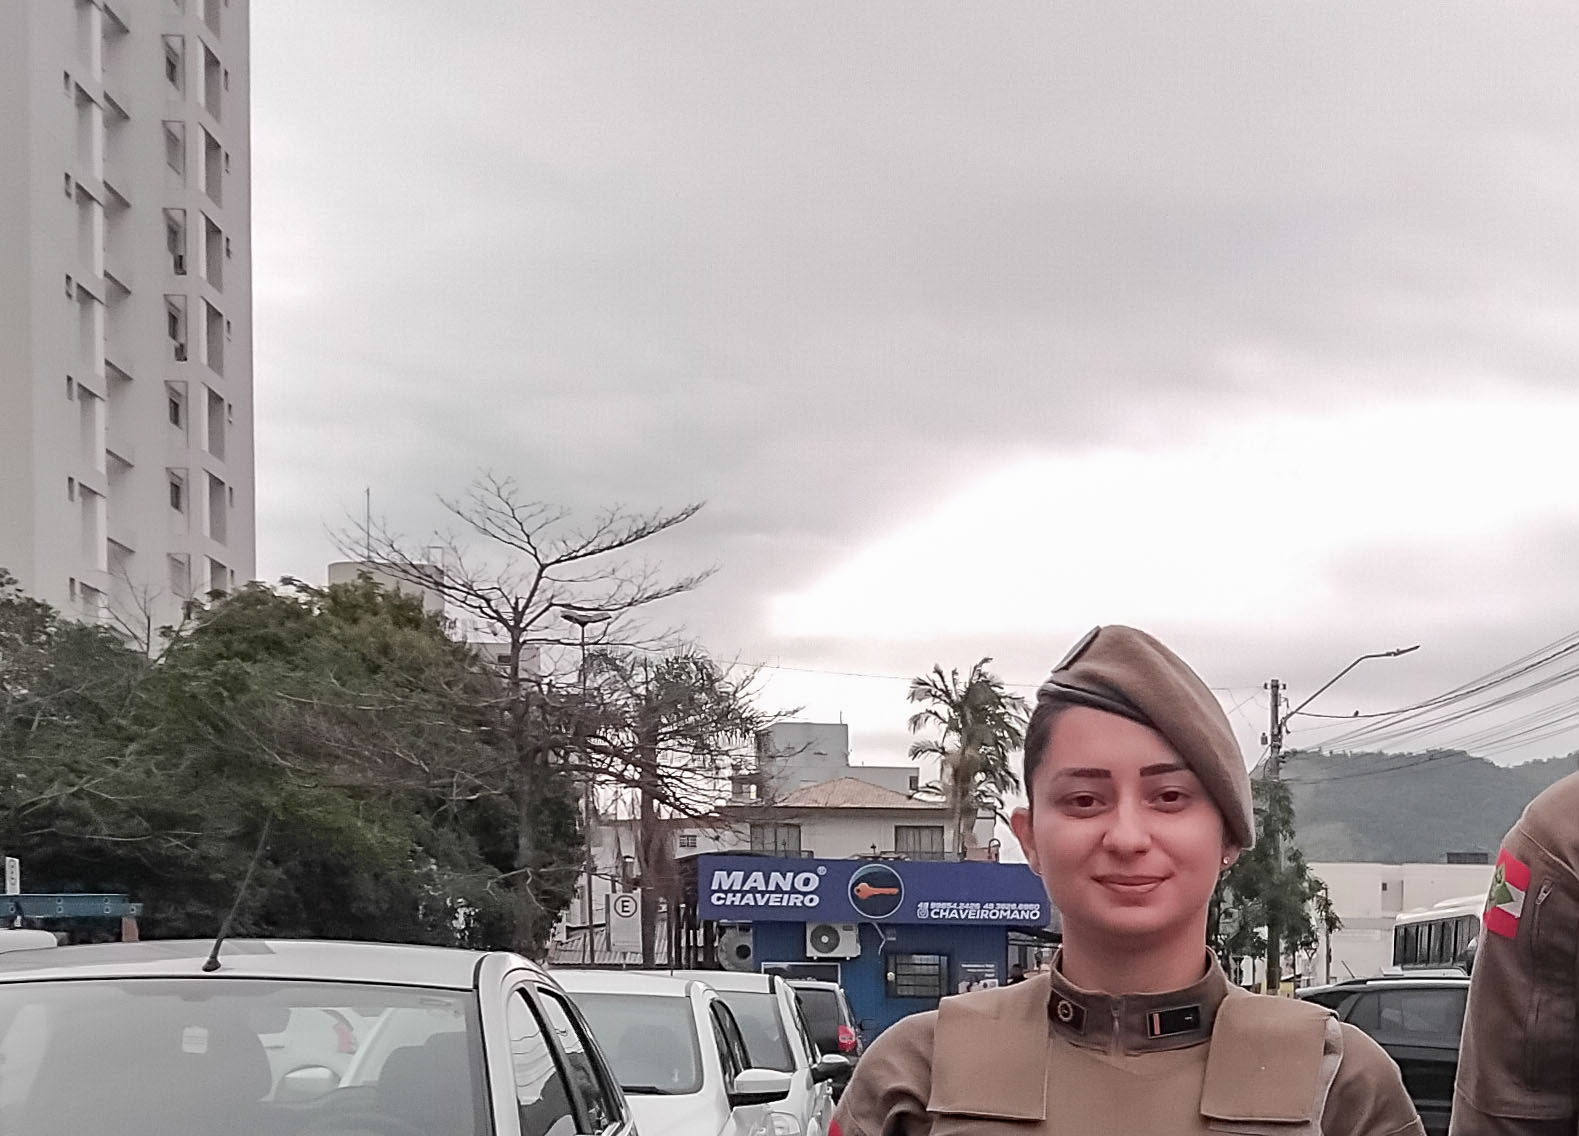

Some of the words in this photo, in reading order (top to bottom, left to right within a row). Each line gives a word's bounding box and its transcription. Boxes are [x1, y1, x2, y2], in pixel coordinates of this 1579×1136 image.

[711, 870, 819, 891] MANO
[621, 900, 631, 913] E
[711, 893, 819, 907] CHAVEIRO
[930, 909, 1040, 920] CHAVEIROMANO
